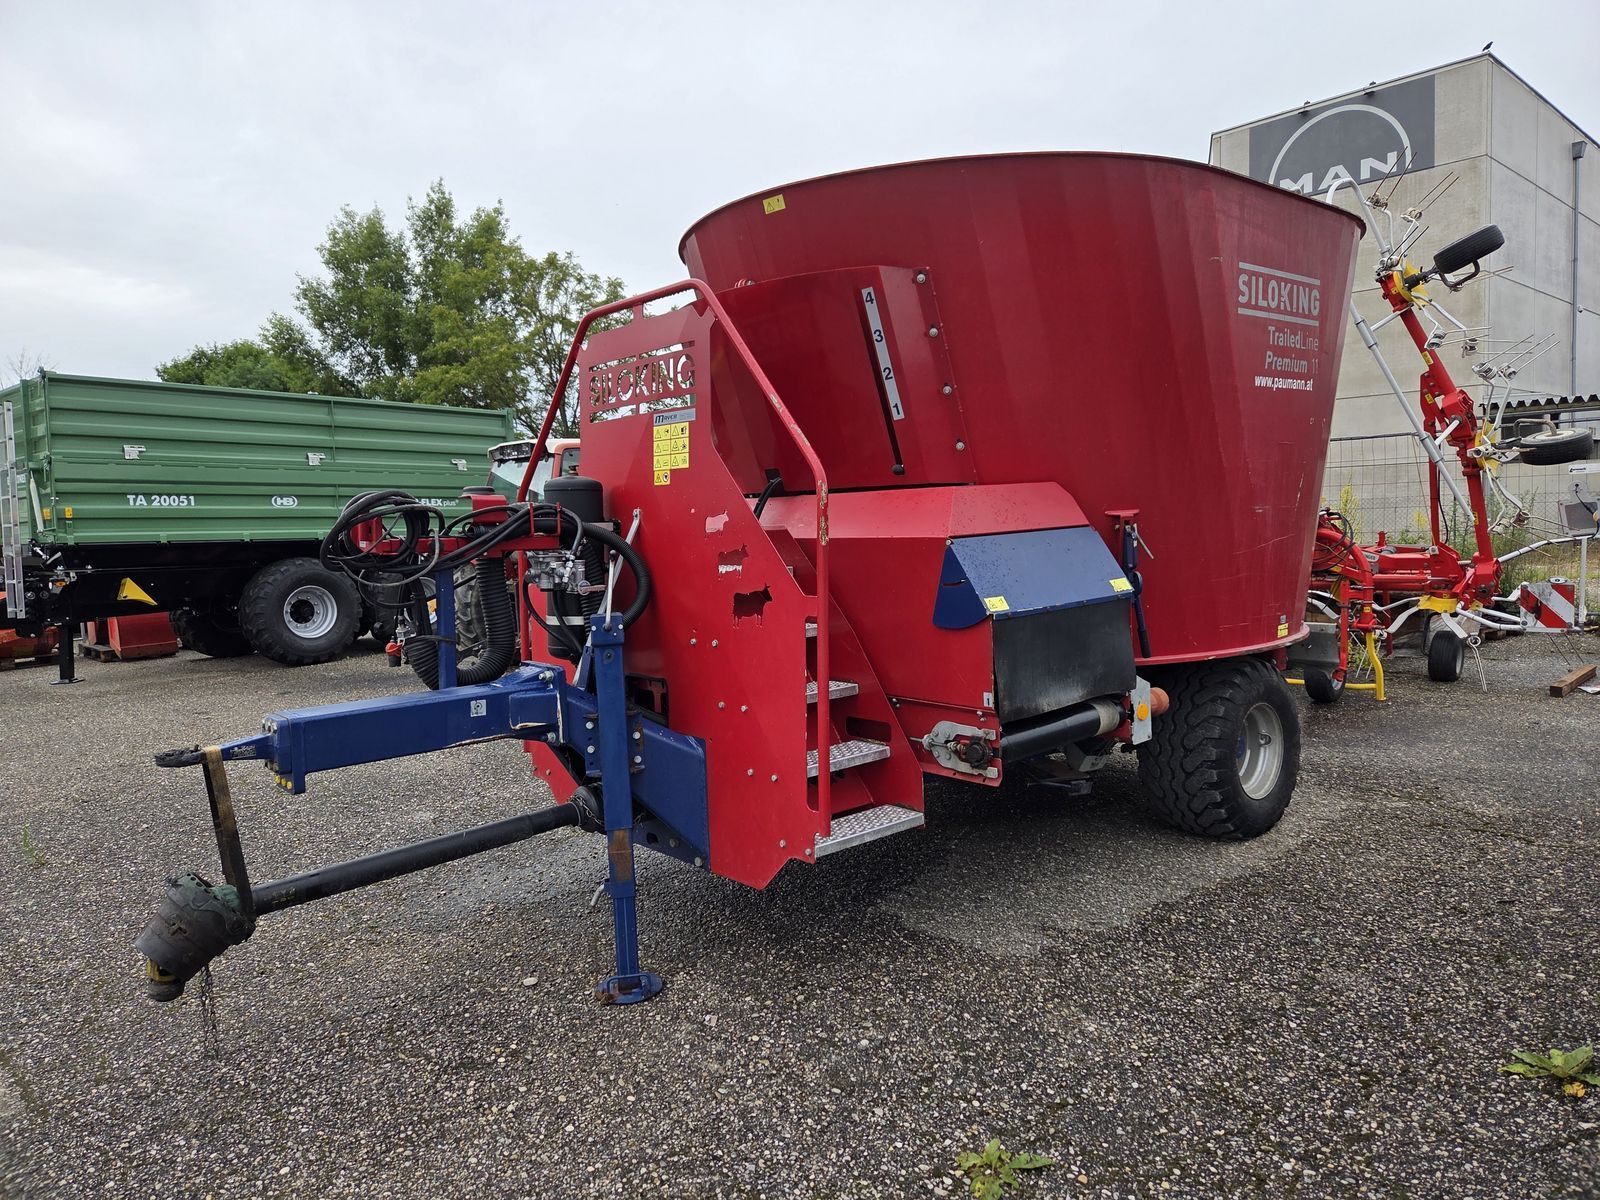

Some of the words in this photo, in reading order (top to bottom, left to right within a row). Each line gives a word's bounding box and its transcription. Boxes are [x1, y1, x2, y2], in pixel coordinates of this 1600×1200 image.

[1279, 151, 1397, 194] MAN
[865, 291, 874, 304] 4
[1238, 273, 1320, 317] SILOKING
[873, 329, 883, 342] 3
[1268, 325, 1319, 351] TrailedLine
[1265, 350, 1308, 374] Premium
[589, 354, 695, 407] SILOKING
[882, 367, 893, 380] 2
[1254, 375, 1313, 392] www.paumann.at
[892, 402, 900, 415] 1
[127, 494, 147, 506] TA
[151, 495, 195, 506] 20051
